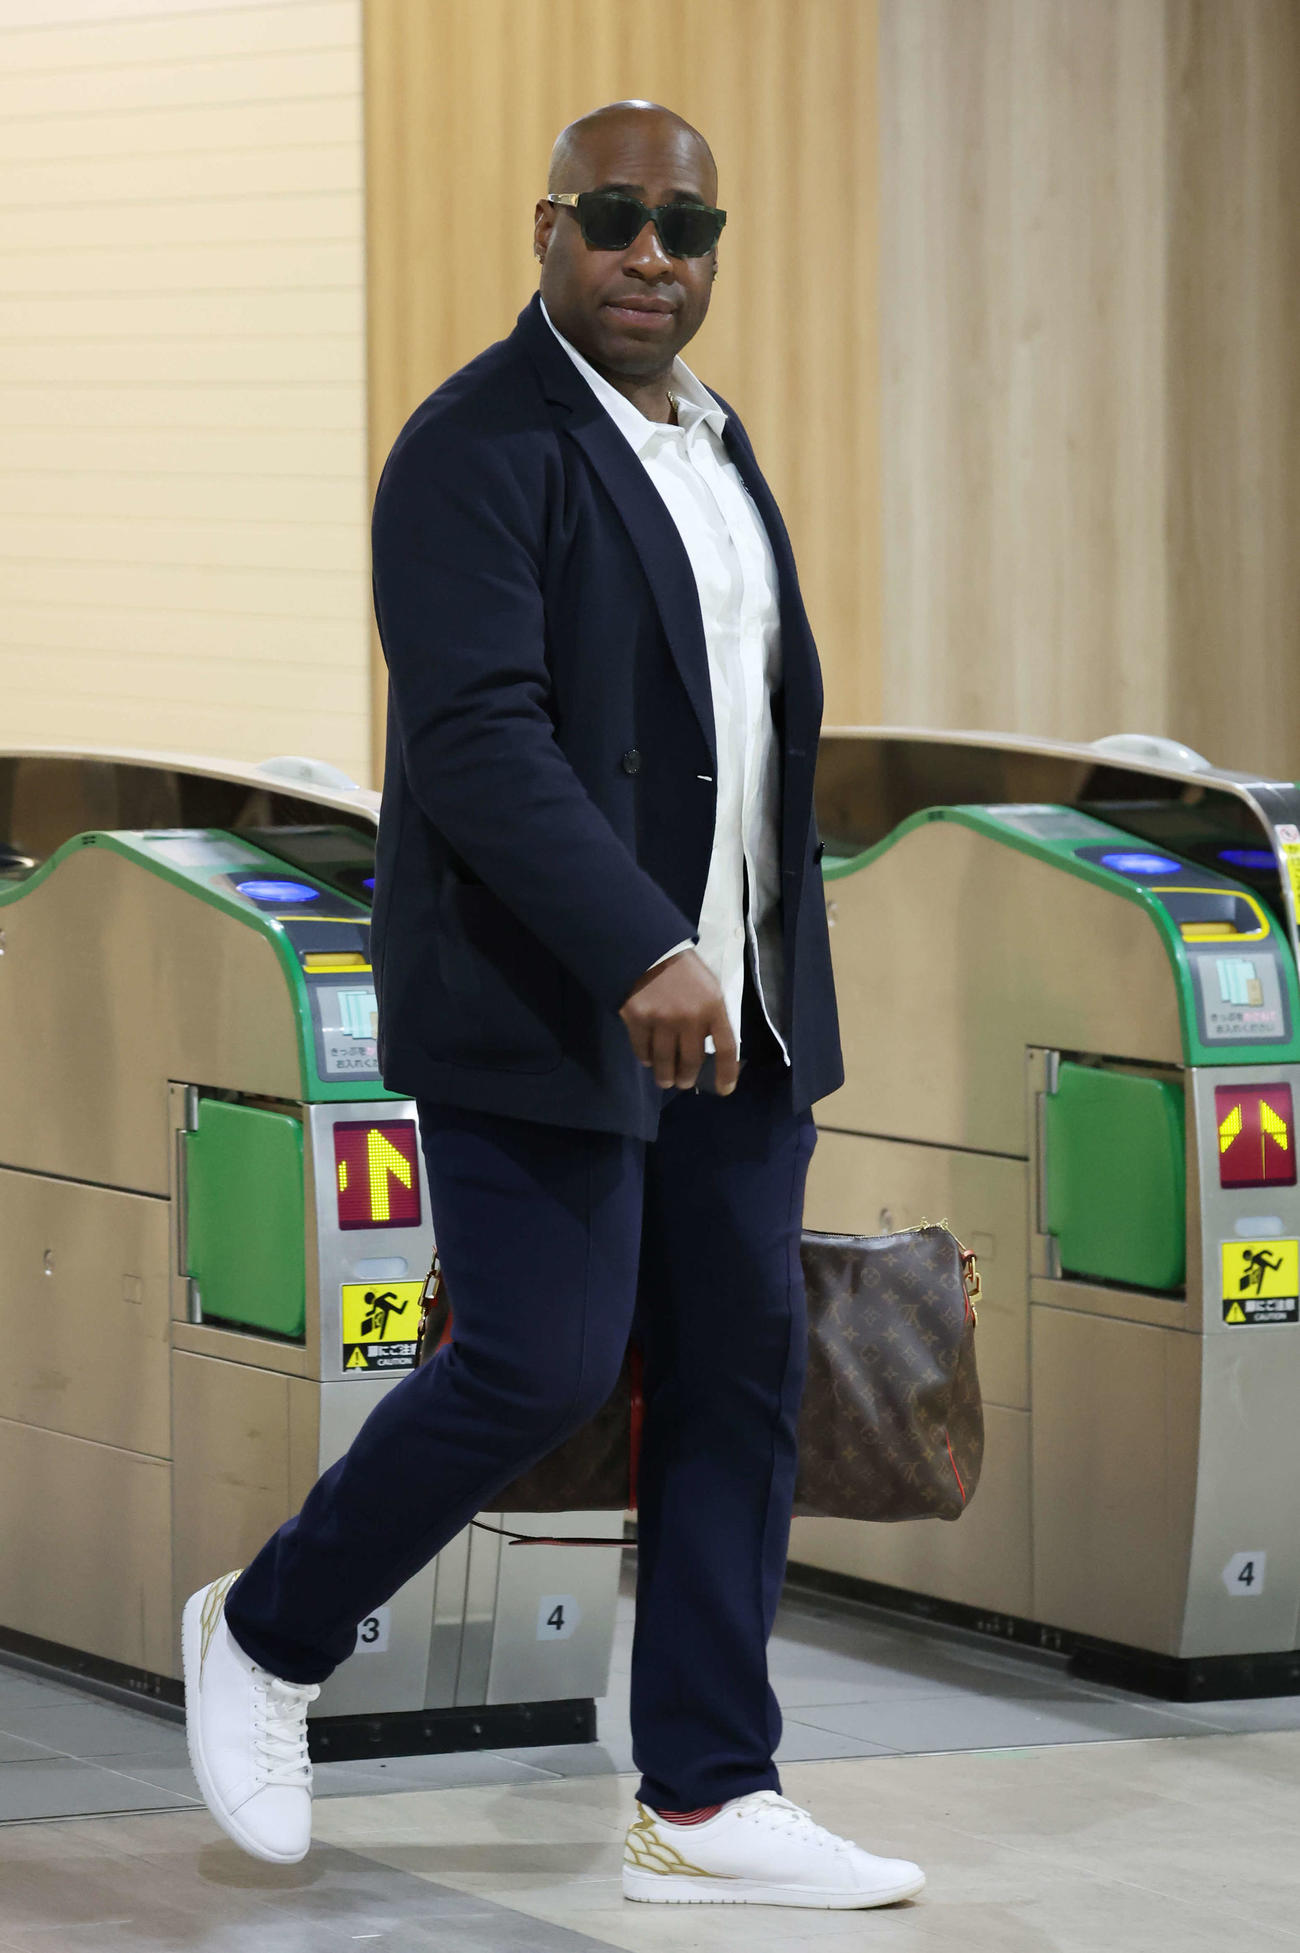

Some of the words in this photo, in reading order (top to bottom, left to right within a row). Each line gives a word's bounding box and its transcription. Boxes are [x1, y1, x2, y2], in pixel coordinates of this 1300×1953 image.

[1254, 1312, 1288, 1321] CAUTION
[377, 1357, 413, 1367] CAUTION
[1237, 1561, 1255, 1587] 4
[361, 1617, 380, 1643] 3
[546, 1604, 566, 1631] 4
